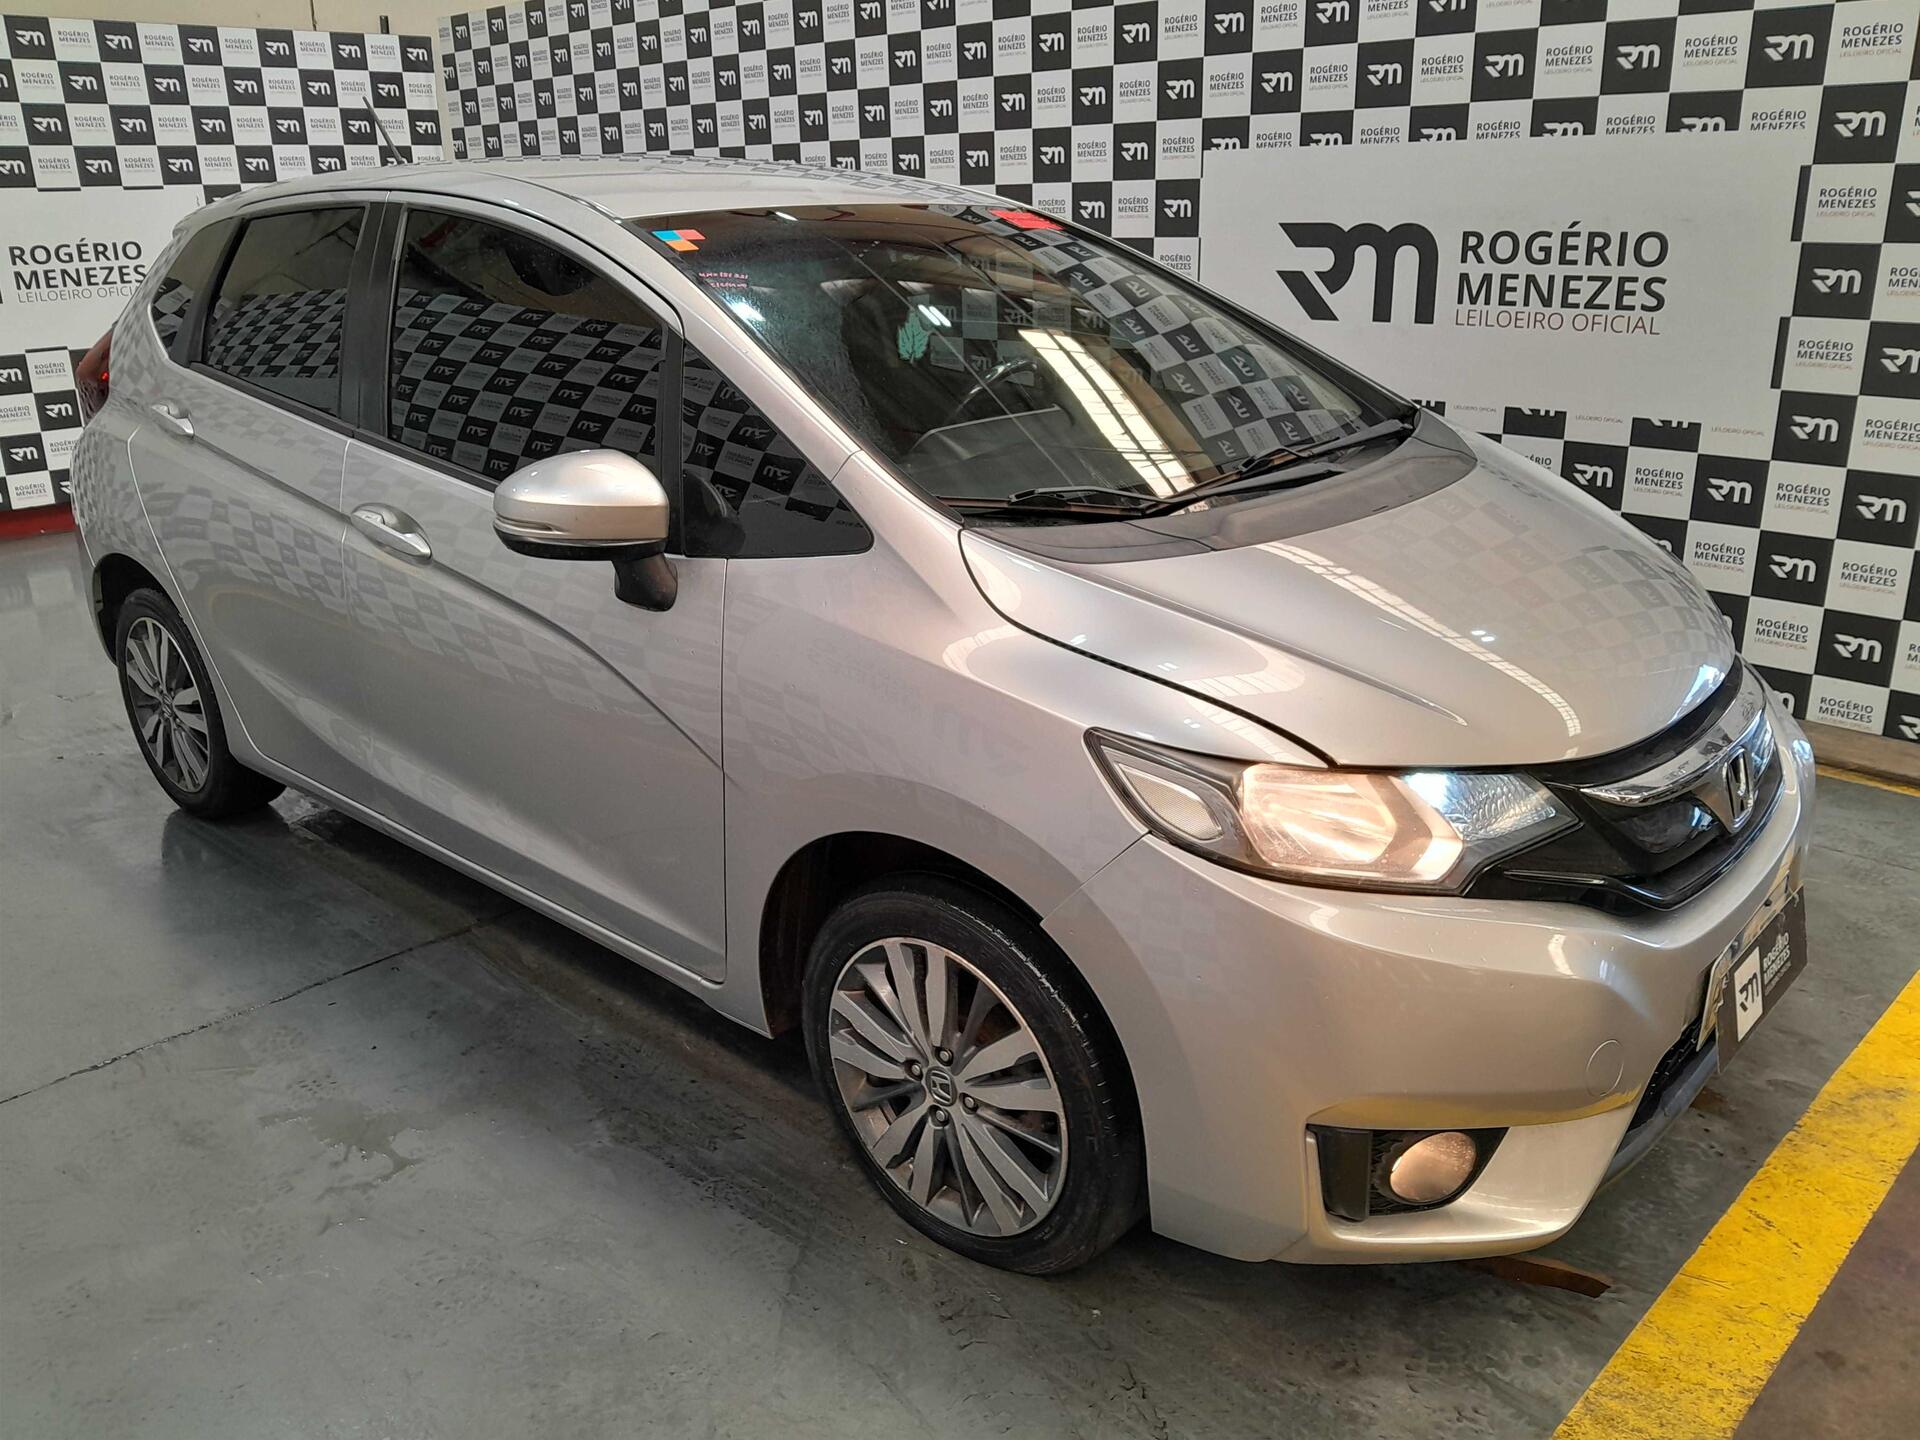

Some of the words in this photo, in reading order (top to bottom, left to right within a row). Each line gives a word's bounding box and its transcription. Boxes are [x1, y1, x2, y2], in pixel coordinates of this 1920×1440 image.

[1367, 0, 1409, 12] MENEZES
[1842, 23, 1904, 37] ROGÉRIO
[1684, 35, 1738, 48] ROGÉRIO
[1840, 35, 1902, 49] MENEZES
[1545, 44, 1593, 57] ROGÉRIO
[1683, 46, 1737, 58] MENEZES
[1421, 54, 1464, 66] ROGÉRIO
[1544, 54, 1593, 67] MENEZES
[1421, 64, 1464, 75] MENEZES
[1606, 114, 1656, 126] ROGÉRIO
[1750, 109, 1807, 121] ROGÉRIO
[1476, 120, 1521, 131] ROGÉRIO
[1819, 185, 1878, 197] ROGÉRIO
[1817, 198, 1877, 208] MENEZES
[8, 237, 142, 266] ROGÉRIO
[1460, 221, 1669, 268] ROGÉRIO
[13, 264, 147, 290] MENEZES
[18, 288, 92, 304] LEILOEIRO
[1457, 273, 1667, 312] MENEZES
[1454, 309, 1564, 331] LEILOEIRO
[1572, 311, 1661, 335] OFICIAL
[1797, 339, 1854, 351] ROGÉRIO
[1796, 349, 1853, 361] MENEZES
[1635, 467, 1684, 480] ROGÉRIO
[1634, 476, 1683, 490] MENEZES
[1777, 482, 1831, 496] ROGÉRIO
[1775, 492, 1830, 506] MENEZES
[1694, 540, 1745, 555] ROGÉRIO
[1693, 549, 1744, 564] MENEZES
[1841, 561, 1899, 578] ROGÉRIO
[1839, 570, 1898, 588] MENEZES
[1756, 617, 1809, 633] ROGÉRIO
[1754, 625, 1808, 642] MENEZES
[1819, 696, 1874, 714] ROGÉRIO
[1818, 704, 1872, 723] MENEZES
